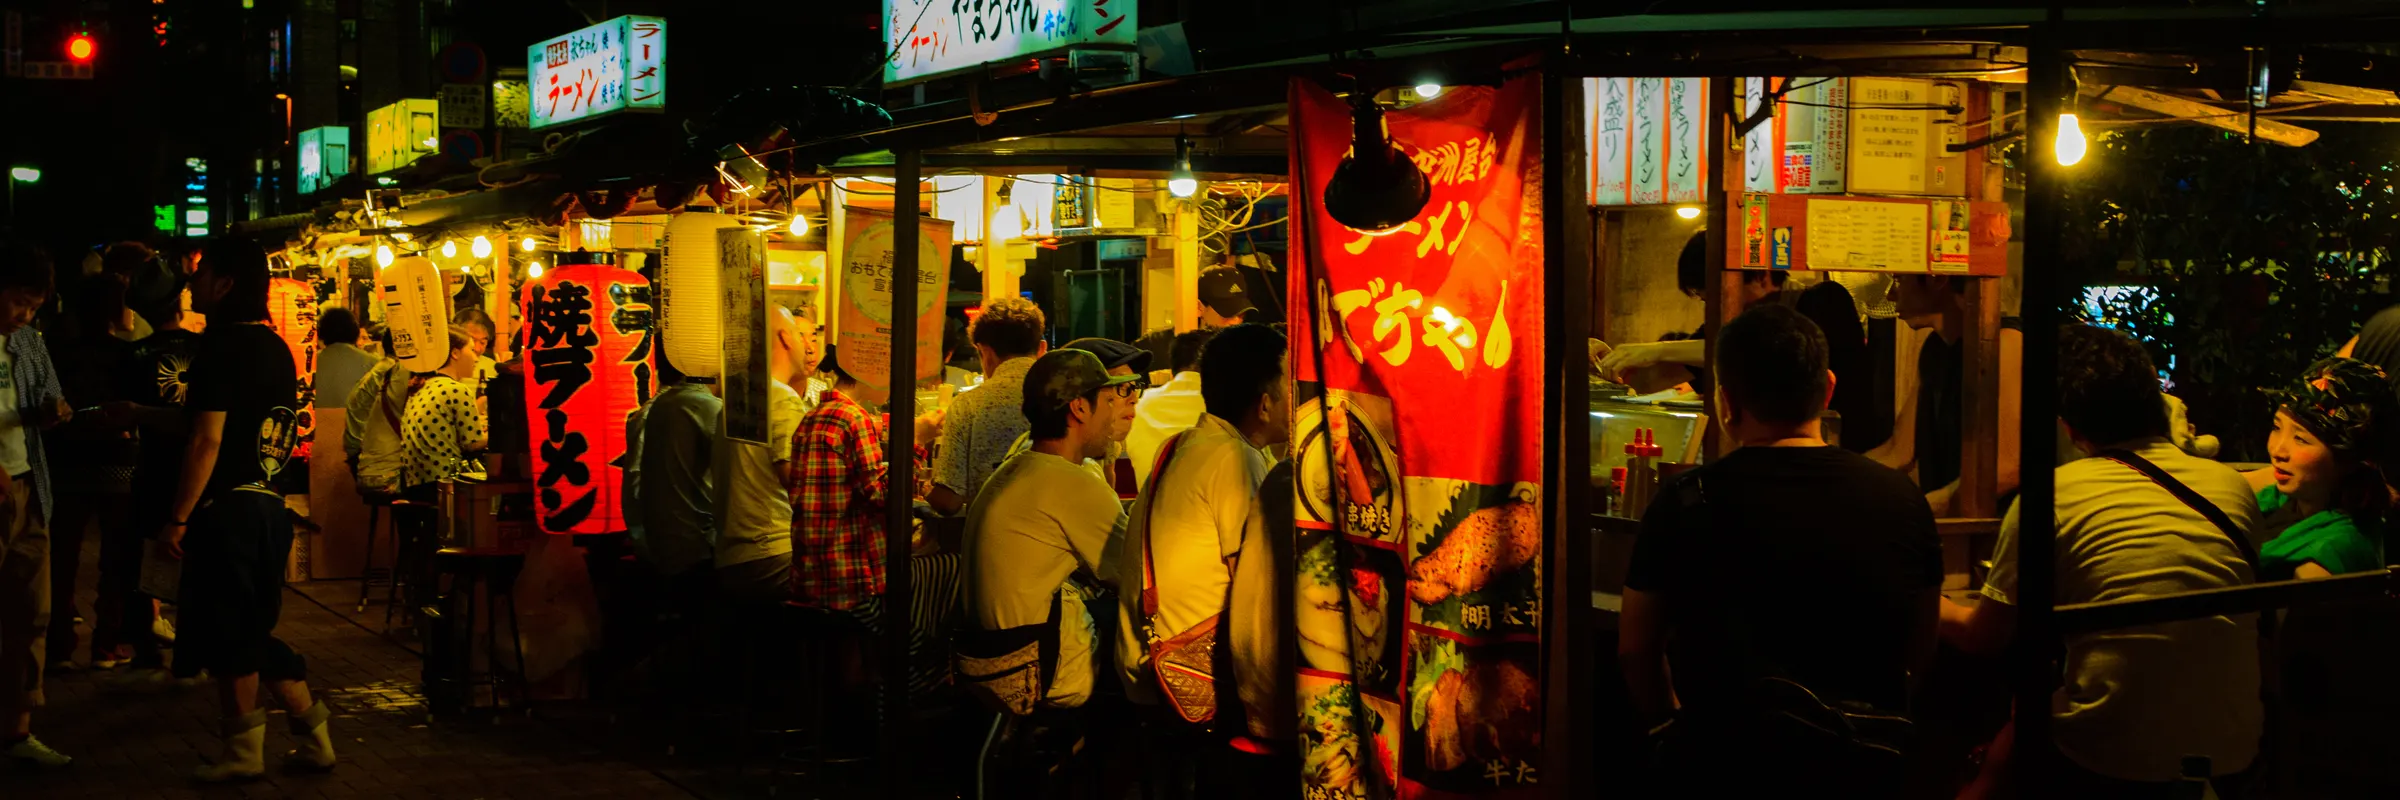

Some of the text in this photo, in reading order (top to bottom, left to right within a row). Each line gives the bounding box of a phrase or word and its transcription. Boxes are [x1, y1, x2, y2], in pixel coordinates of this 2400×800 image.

[911, 17, 948, 67] ラーメン
[952, 0, 1039, 44] やまちゃん
[1043, 7, 1077, 41] 牛たん
[1093, 0, 1126, 36] ン
[631, 23, 661, 102] ラーメン
[548, 68, 599, 117] ラーメン
[1344, 201, 1471, 258] メン
[527, 280, 600, 533] 焼ラーメン
[1347, 501, 1391, 535] 串焼き
